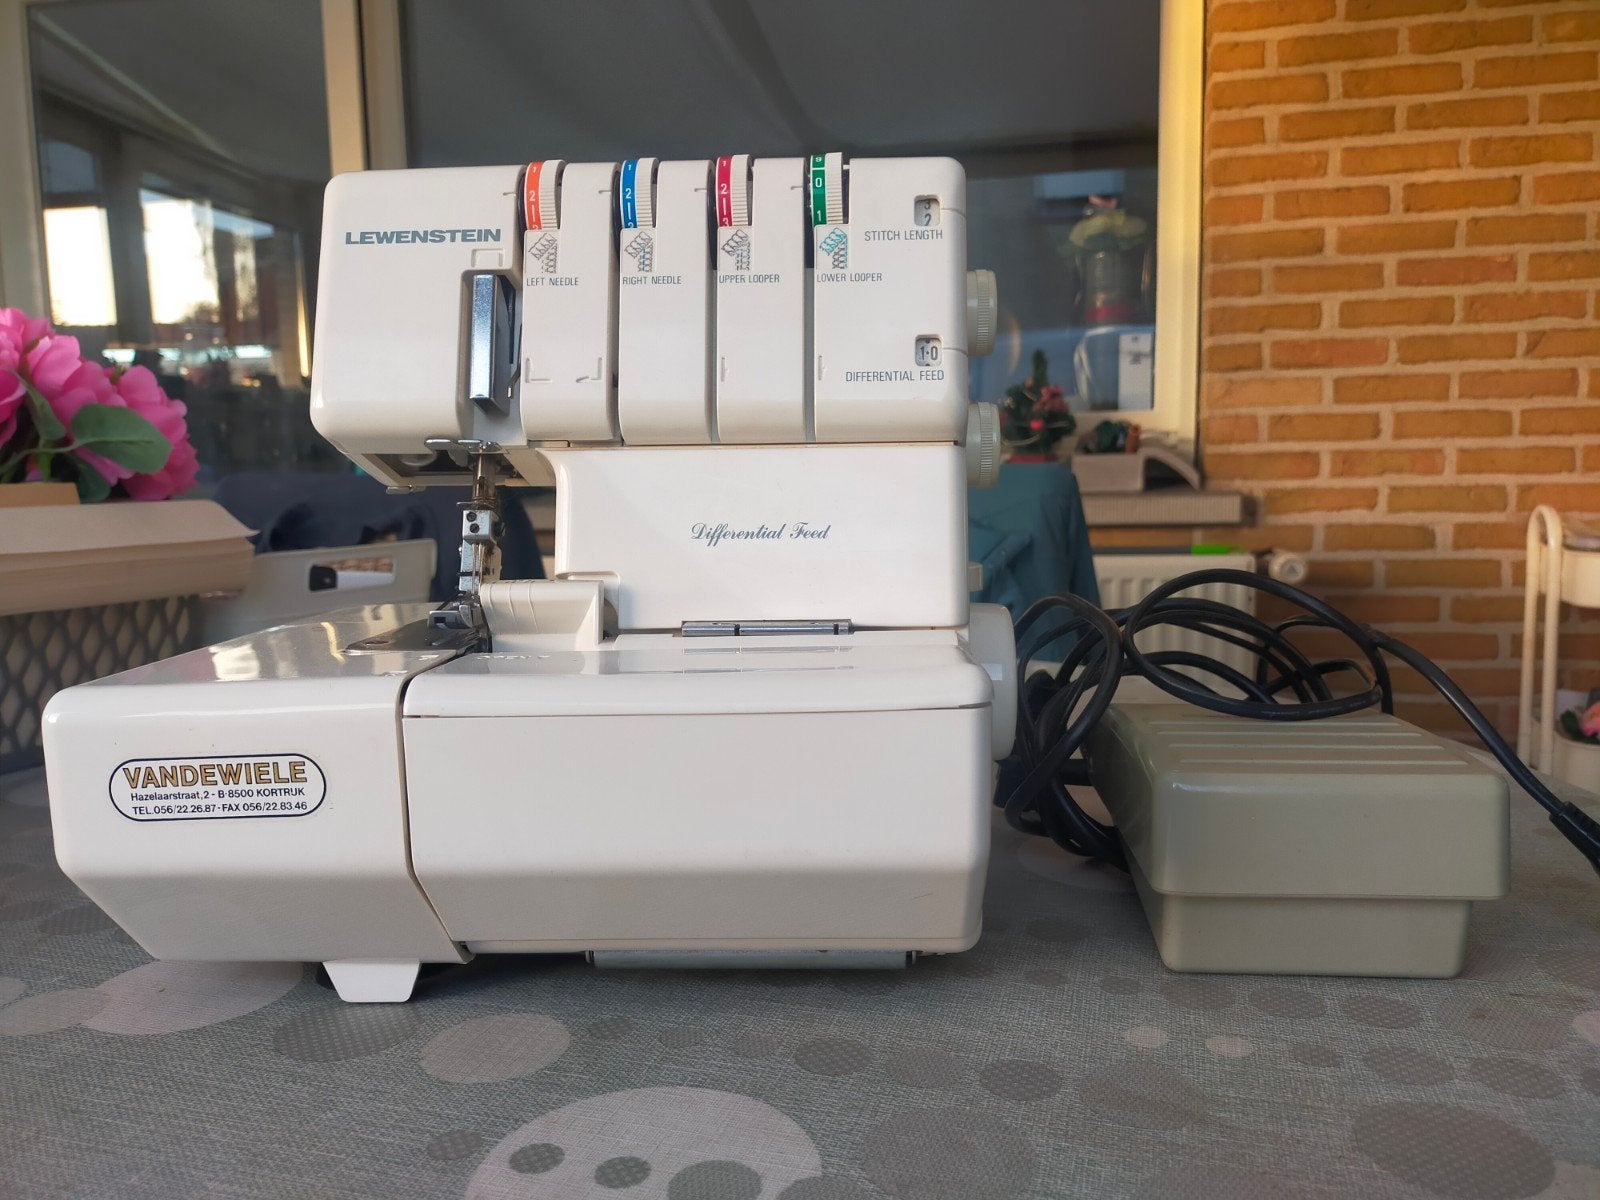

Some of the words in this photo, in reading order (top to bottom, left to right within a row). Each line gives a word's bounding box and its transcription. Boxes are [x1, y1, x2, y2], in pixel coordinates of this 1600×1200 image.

[815, 177, 823, 188] 0
[625, 187, 632, 199] 2
[721, 183, 728, 195] 2
[529, 190, 536, 202] 2
[816, 210, 822, 222] 1
[345, 228, 502, 245] LEWENSTEIN
[864, 231, 901, 242] STITCH
[904, 230, 943, 241] LENGTH
[526, 277, 544, 287] LEFT
[548, 276, 579, 287] NEEDLE
[622, 276, 648, 286] RIGHT
[651, 275, 682, 285] NEEDLE
[719, 274, 746, 284] UPPER
[748, 273, 780, 284] LOOPER
[816, 273, 847, 283] LOWER
[849, 272, 883, 283] LOOPER
[845, 370, 915, 382] DIFFERENTIAL
[919, 369, 945, 381] FEED
[690, 522, 787, 547] Differential
[789, 521, 832, 540] Feed
[122, 760, 308, 789] VANDEWIELE
[256, 786, 306, 798] KORTRIJK
[242, 801, 308, 812] 056/22.83.46
